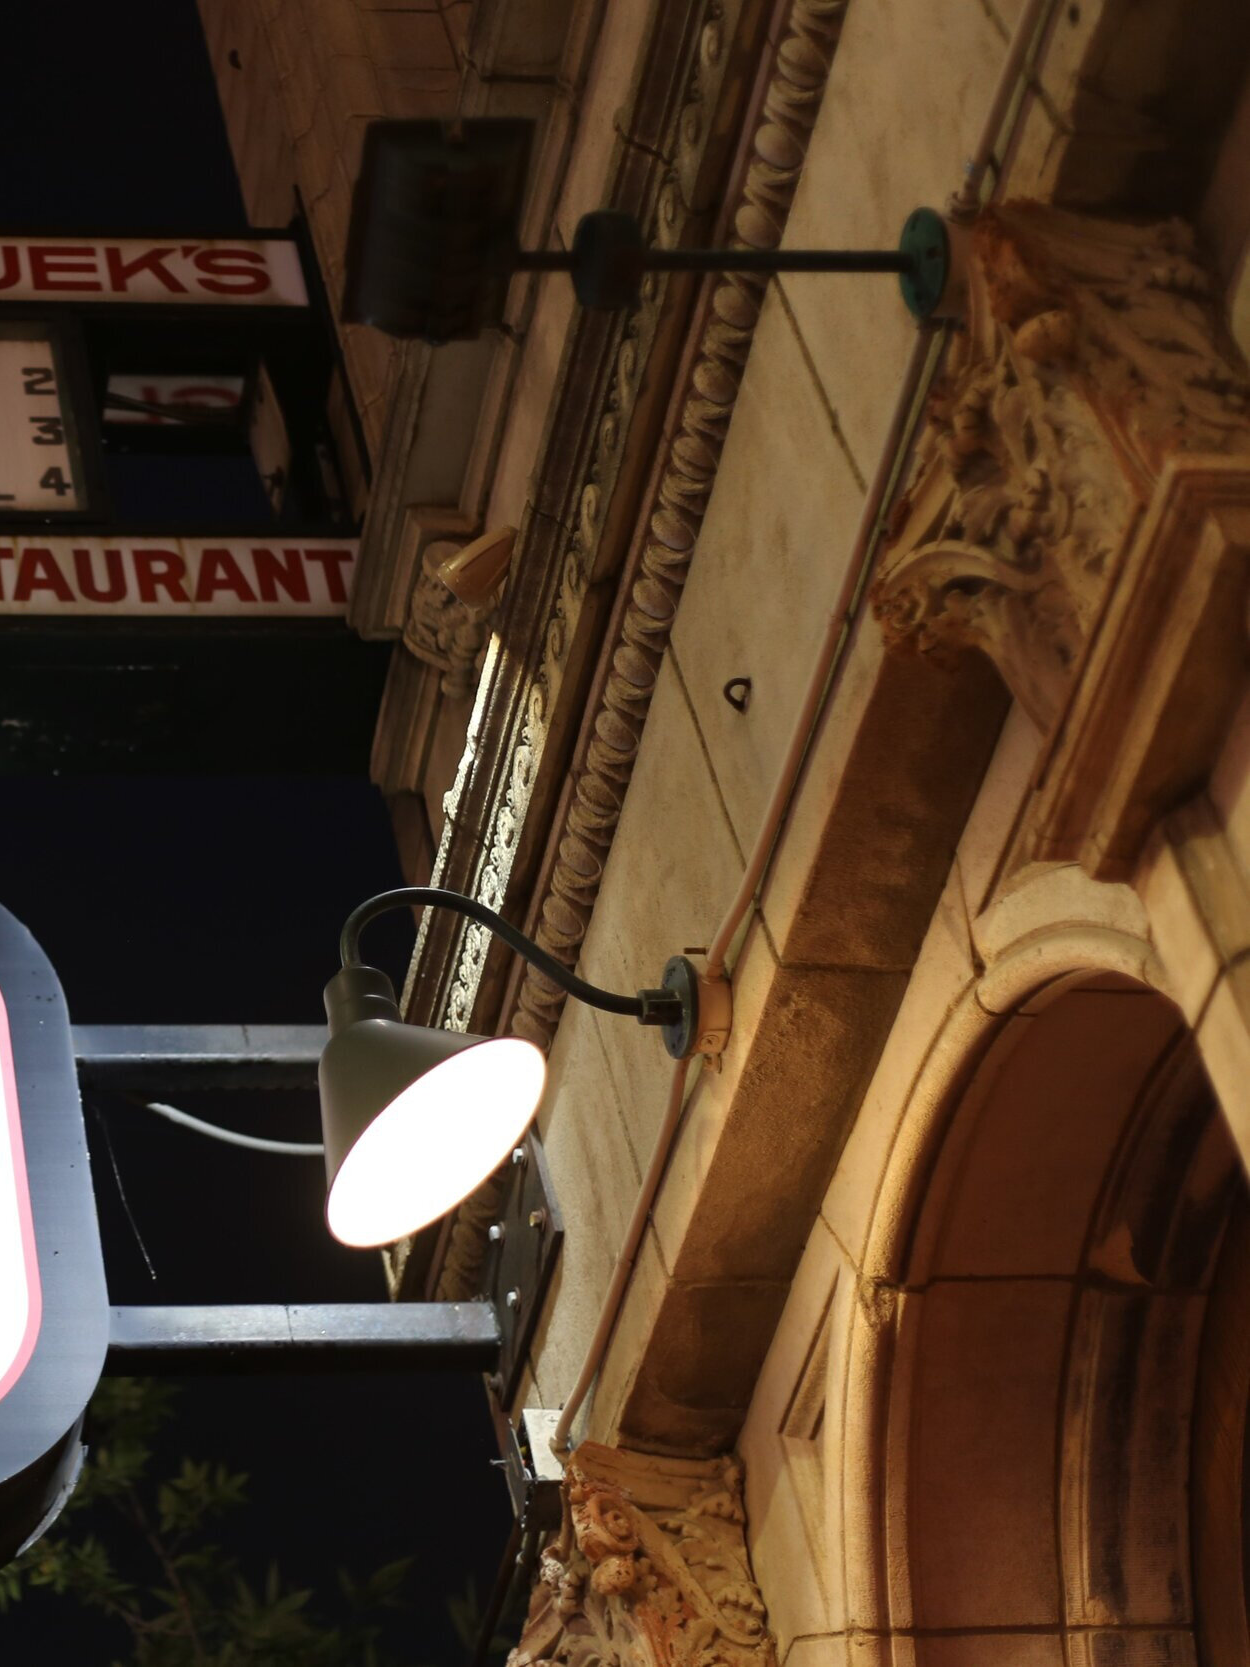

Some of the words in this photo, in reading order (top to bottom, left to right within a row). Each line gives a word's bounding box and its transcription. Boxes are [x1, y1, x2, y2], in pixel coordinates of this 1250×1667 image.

[21, 367, 56, 395] 2
[29, 417, 64, 445] 3
[39, 467, 71, 496] 4
